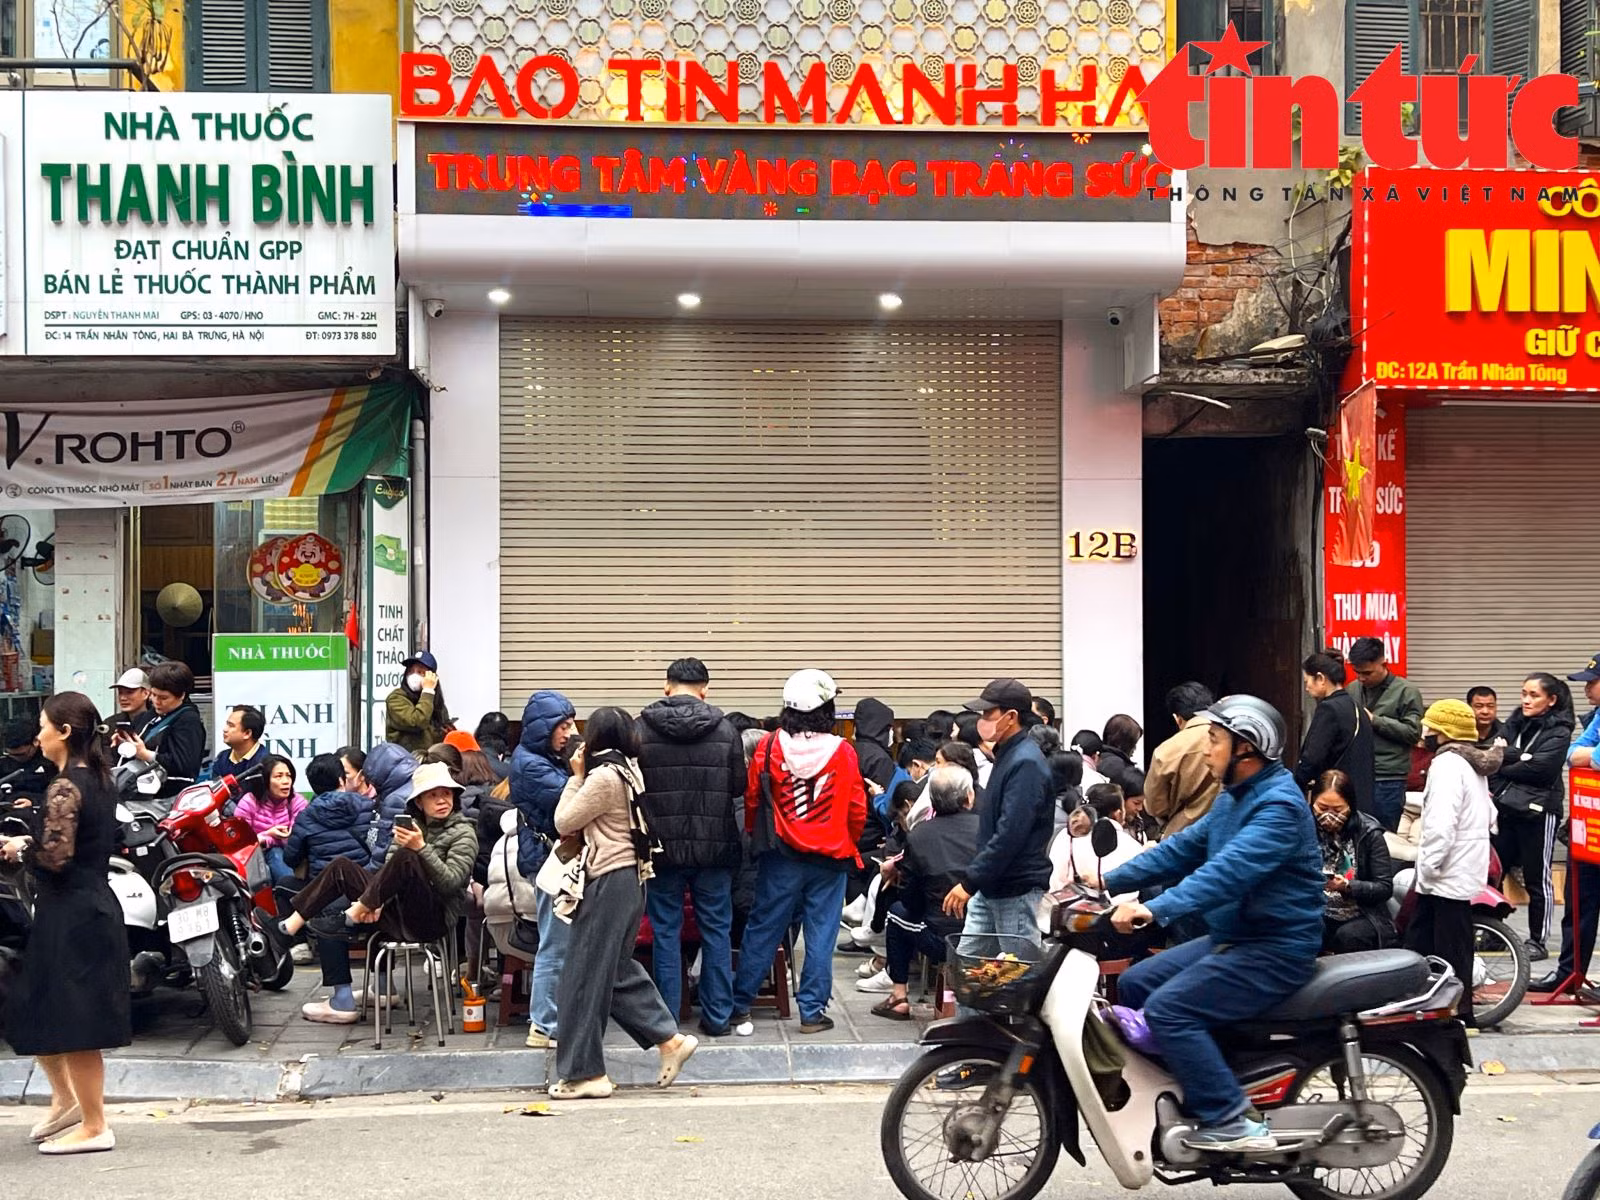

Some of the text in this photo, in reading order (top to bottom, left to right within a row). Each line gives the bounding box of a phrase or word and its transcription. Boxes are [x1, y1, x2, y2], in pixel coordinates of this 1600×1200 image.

[104, 102, 314, 142] NHÀ THUỐC
[41, 150, 375, 226] THANH BÌNH
[427, 147, 1172, 204] TRUNG TÂM VÀNG BẠC TRANG SỨC
[115, 231, 302, 264] ĐẠT CHUẨN GPP
[44, 266, 376, 296] BÁN LẺ THUỐC THÀNH PHẨM
[111, 311, 141, 320] THANH
[143, 311, 159, 320] MAI
[103, 329, 128, 340] NHÂN
[163, 331, 178, 340] HAI
[182, 330, 194, 340] BÀ
[232, 330, 245, 340] HÀ
[321, 331, 342, 340] 0973
[344, 331, 359, 340] 378
[361, 331, 377, 340] 880
[1525, 325, 1581, 357] GIỮ
[1407, 362, 1439, 380] 12A
[1482, 363, 1526, 382] Nhân
[1528, 363, 1568, 385] Tông
[1377, 428, 1398, 461] KẾ
[162, 475, 169, 489] 1
[216, 470, 238, 487] 27
[1375, 481, 1403, 514] SỨC
[1069, 531, 1138, 558] 12B
[378, 605, 403, 619] TINH
[1333, 592, 1399, 621] THU MUA
[377, 623, 405, 642] CHẤT
[228, 642, 331, 660] NHÀ THUỐC
[376, 646, 405, 664] THẢO
[1378, 631, 1401, 664] ÂY
[225, 703, 334, 725] ANH
[264, 732, 318, 759] ÌNH
